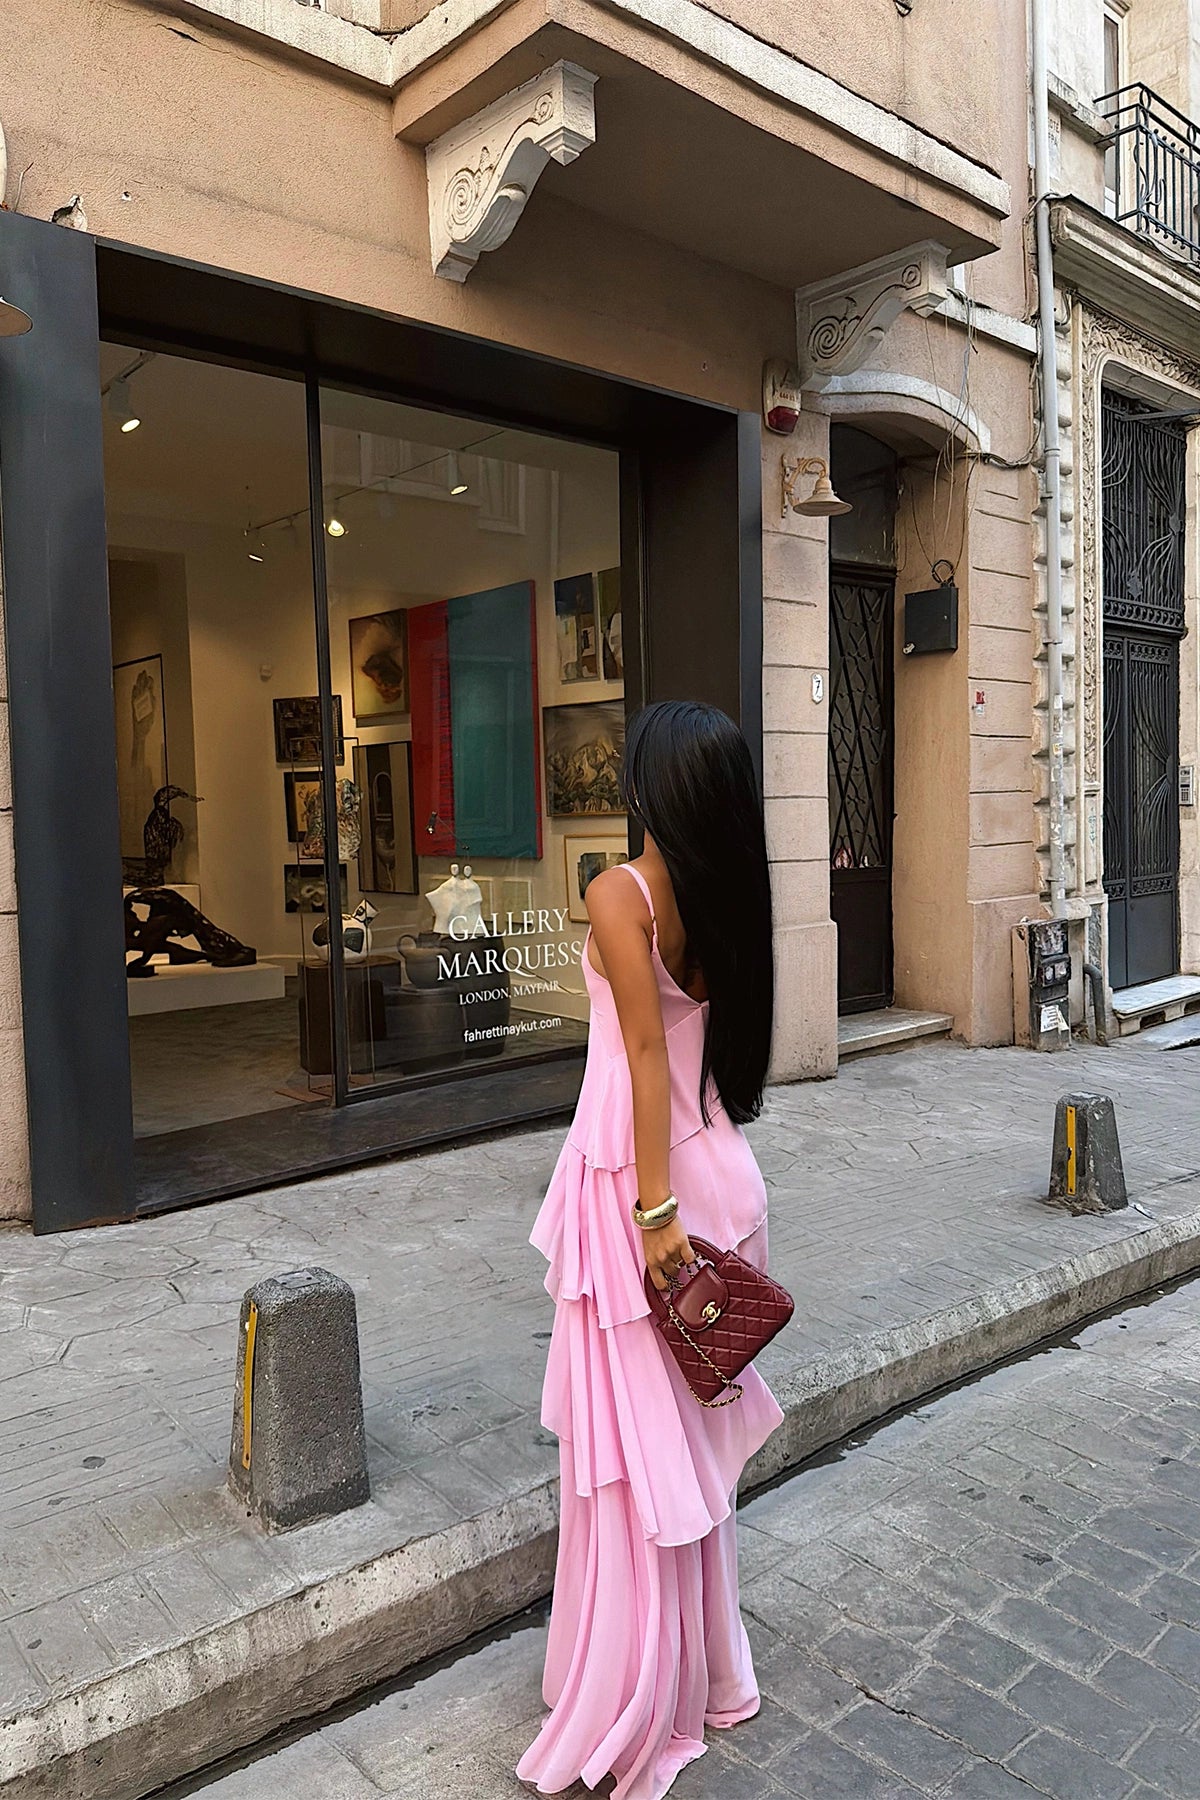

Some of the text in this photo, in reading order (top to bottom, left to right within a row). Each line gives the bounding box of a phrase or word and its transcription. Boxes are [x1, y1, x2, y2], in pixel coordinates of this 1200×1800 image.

[448, 908, 569, 941] GALLERY
[437, 940, 582, 981] MARQUESS
[514, 980, 560, 997] MAYFAIR
[463, 1017, 562, 1043] fahrettinaykut.com
